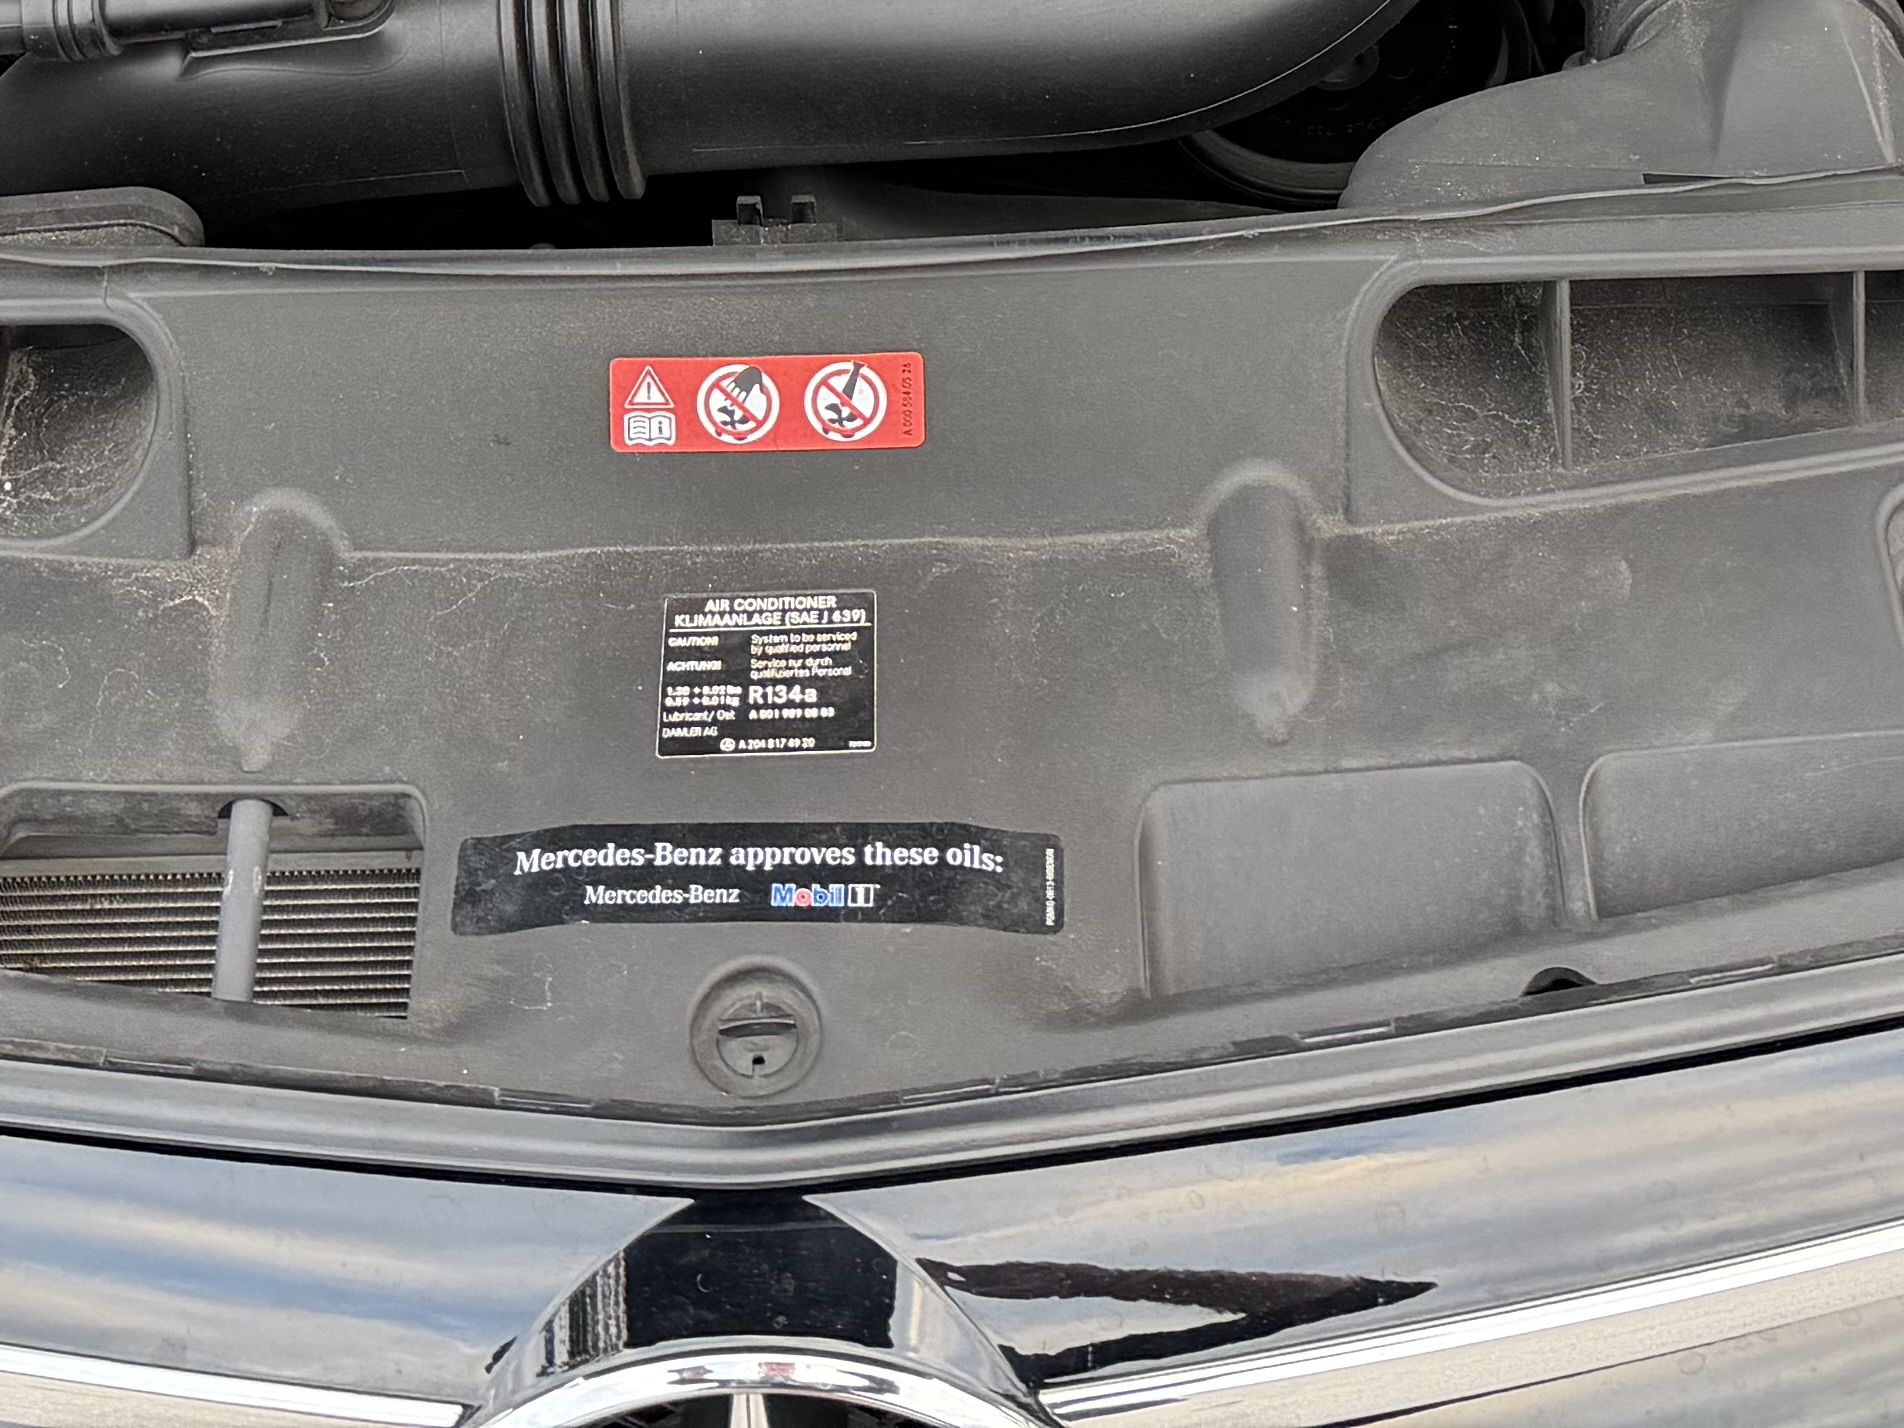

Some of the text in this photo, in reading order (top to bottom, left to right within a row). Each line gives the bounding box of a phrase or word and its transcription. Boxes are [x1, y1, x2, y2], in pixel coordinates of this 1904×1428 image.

[704, 595, 837, 613] AIR CONDITIONER
[674, 611, 782, 627] KLIMAANLAGE
[785, 610, 819, 627] (SAE
[831, 608, 866, 625] 639)
[751, 633, 788, 645] System
[789, 632, 801, 643] to
[801, 632, 815, 642] be
[816, 631, 857, 642] serviced
[750, 644, 763, 656] by
[805, 641, 851, 654] personnel
[750, 658, 787, 669] Service
[805, 657, 833, 667] durch
[811, 665, 852, 677] Personal
[748, 684, 818, 705] R134a
[514, 842, 1004, 876] Mercedes-Benz approves these oils:
[584, 883, 741, 906] Mercedes-Benz
[770, 883, 845, 907] Mobil
